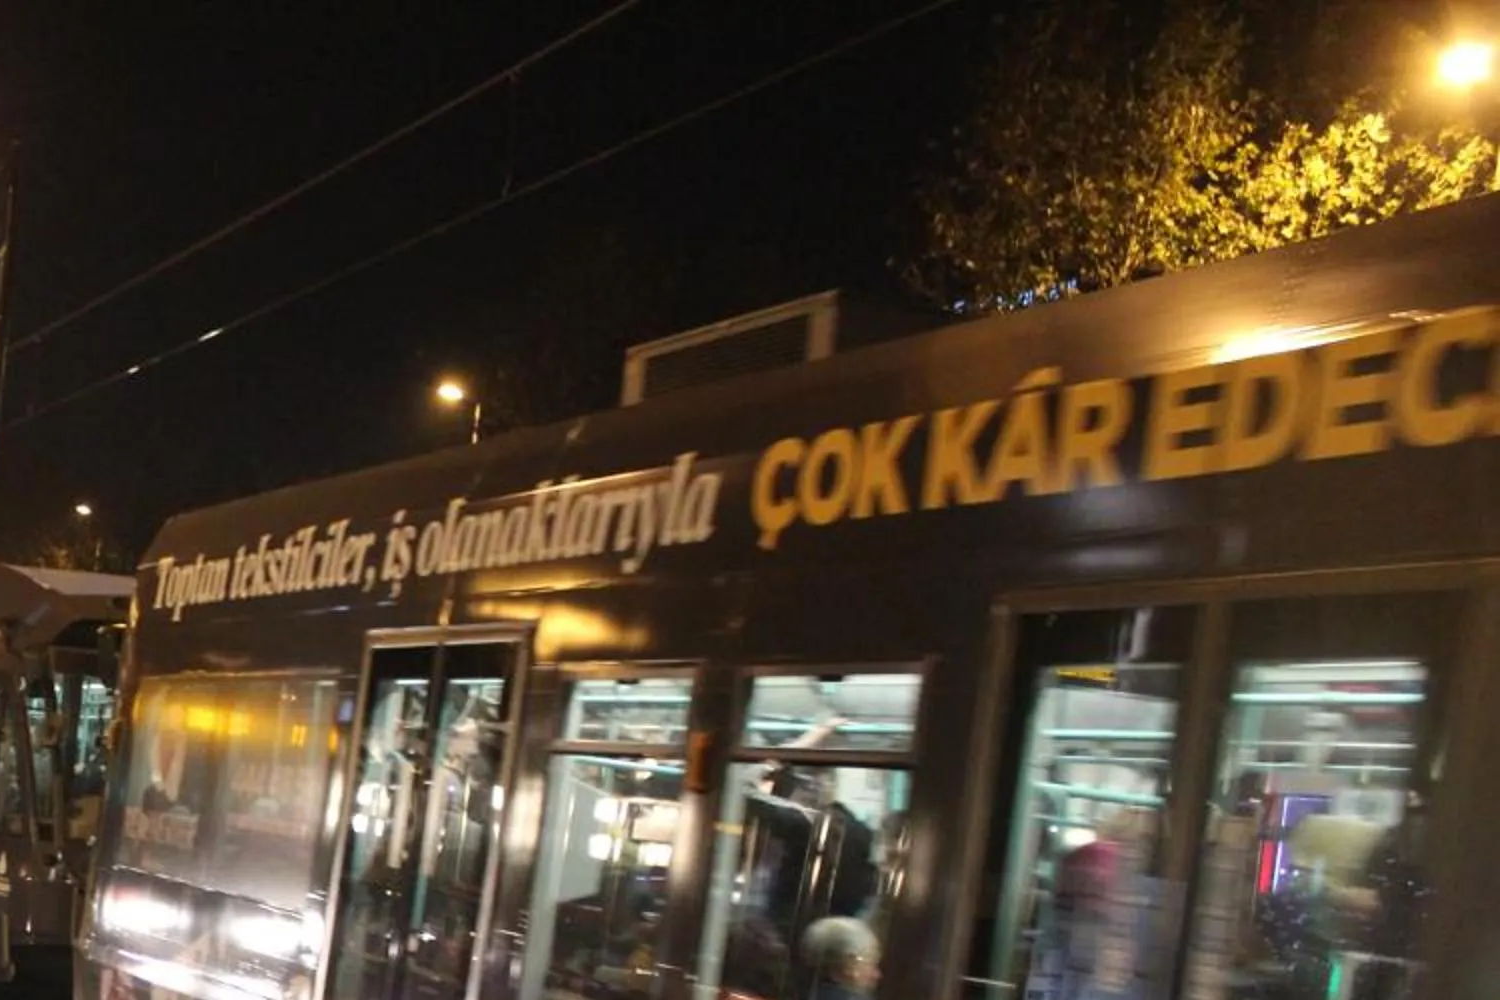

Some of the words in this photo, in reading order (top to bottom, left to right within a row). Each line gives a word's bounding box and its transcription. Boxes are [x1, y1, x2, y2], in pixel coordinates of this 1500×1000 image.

[153, 552, 231, 622] Toptan
[381, 509, 417, 599] iş
[751, 414, 922, 551] ÇOK
[922, 365, 1134, 511] KÂR
[1143, 304, 1500, 482] EDEC
